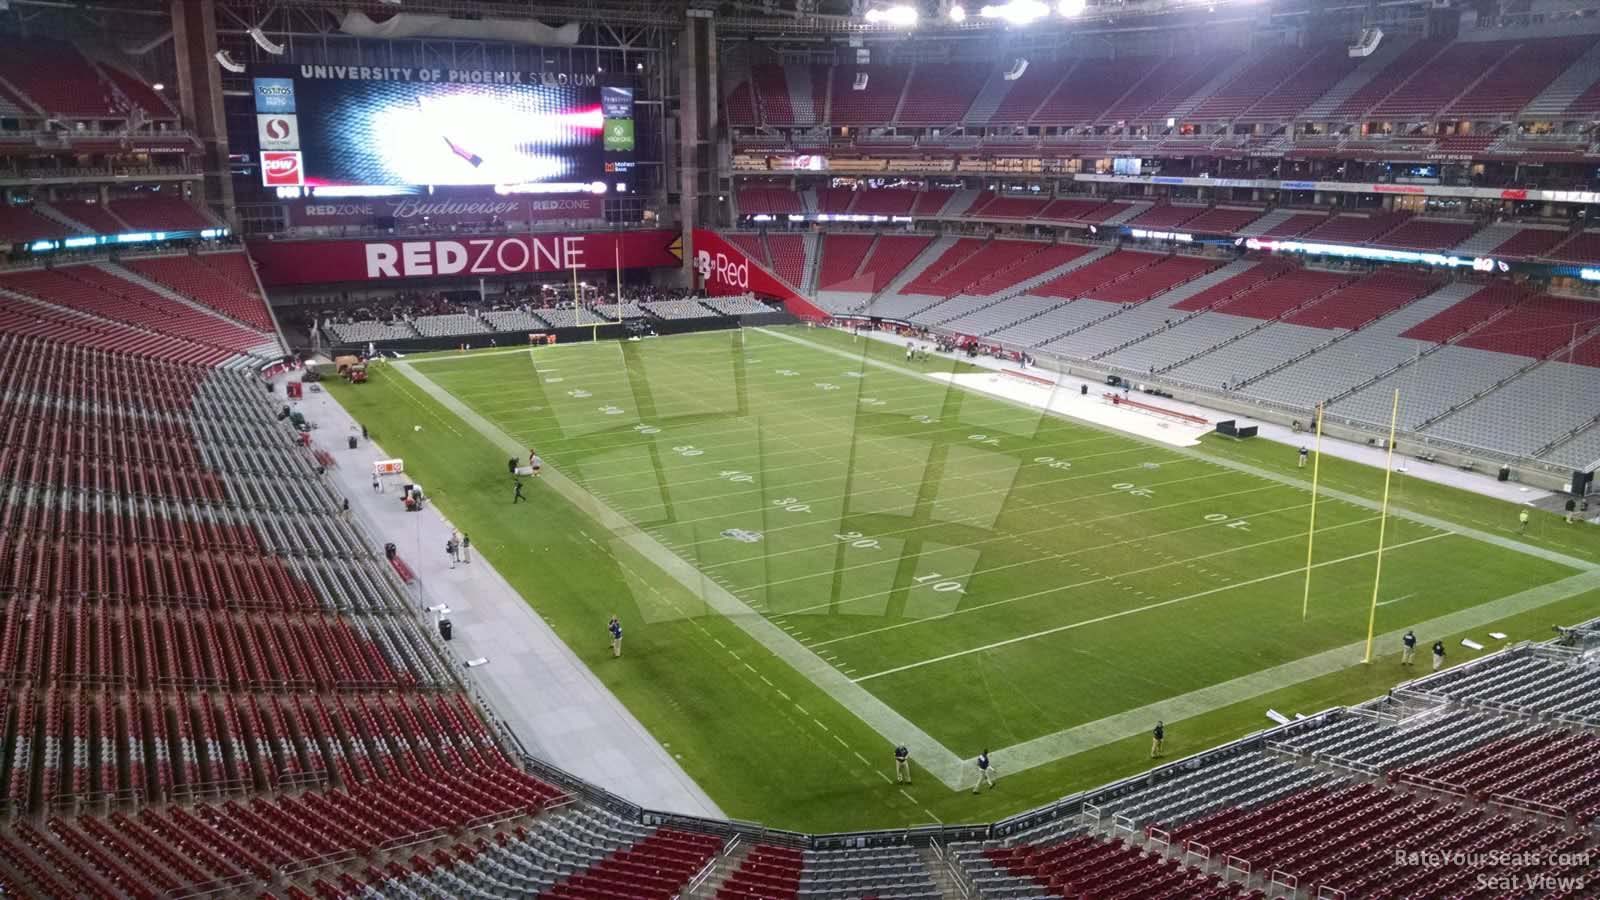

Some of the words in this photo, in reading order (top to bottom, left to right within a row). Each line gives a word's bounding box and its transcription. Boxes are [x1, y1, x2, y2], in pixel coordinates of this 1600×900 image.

[301, 65, 412, 81] UNIVERSITY
[420, 69, 442, 80] OF
[449, 70, 522, 84] PHOENIX
[529, 73, 597, 87] STADIUM
[306, 202, 374, 216] REDZONE
[387, 196, 520, 218] Budweiser
[532, 199, 591, 211] REDZONE
[365, 236, 586, 278] REDZONE
[716, 253, 748, 288] Red
[773, 497, 808, 512] 30
[1204, 513, 1247, 530] 10
[834, 531, 878, 549] 20
[914, 572, 961, 593] 10
